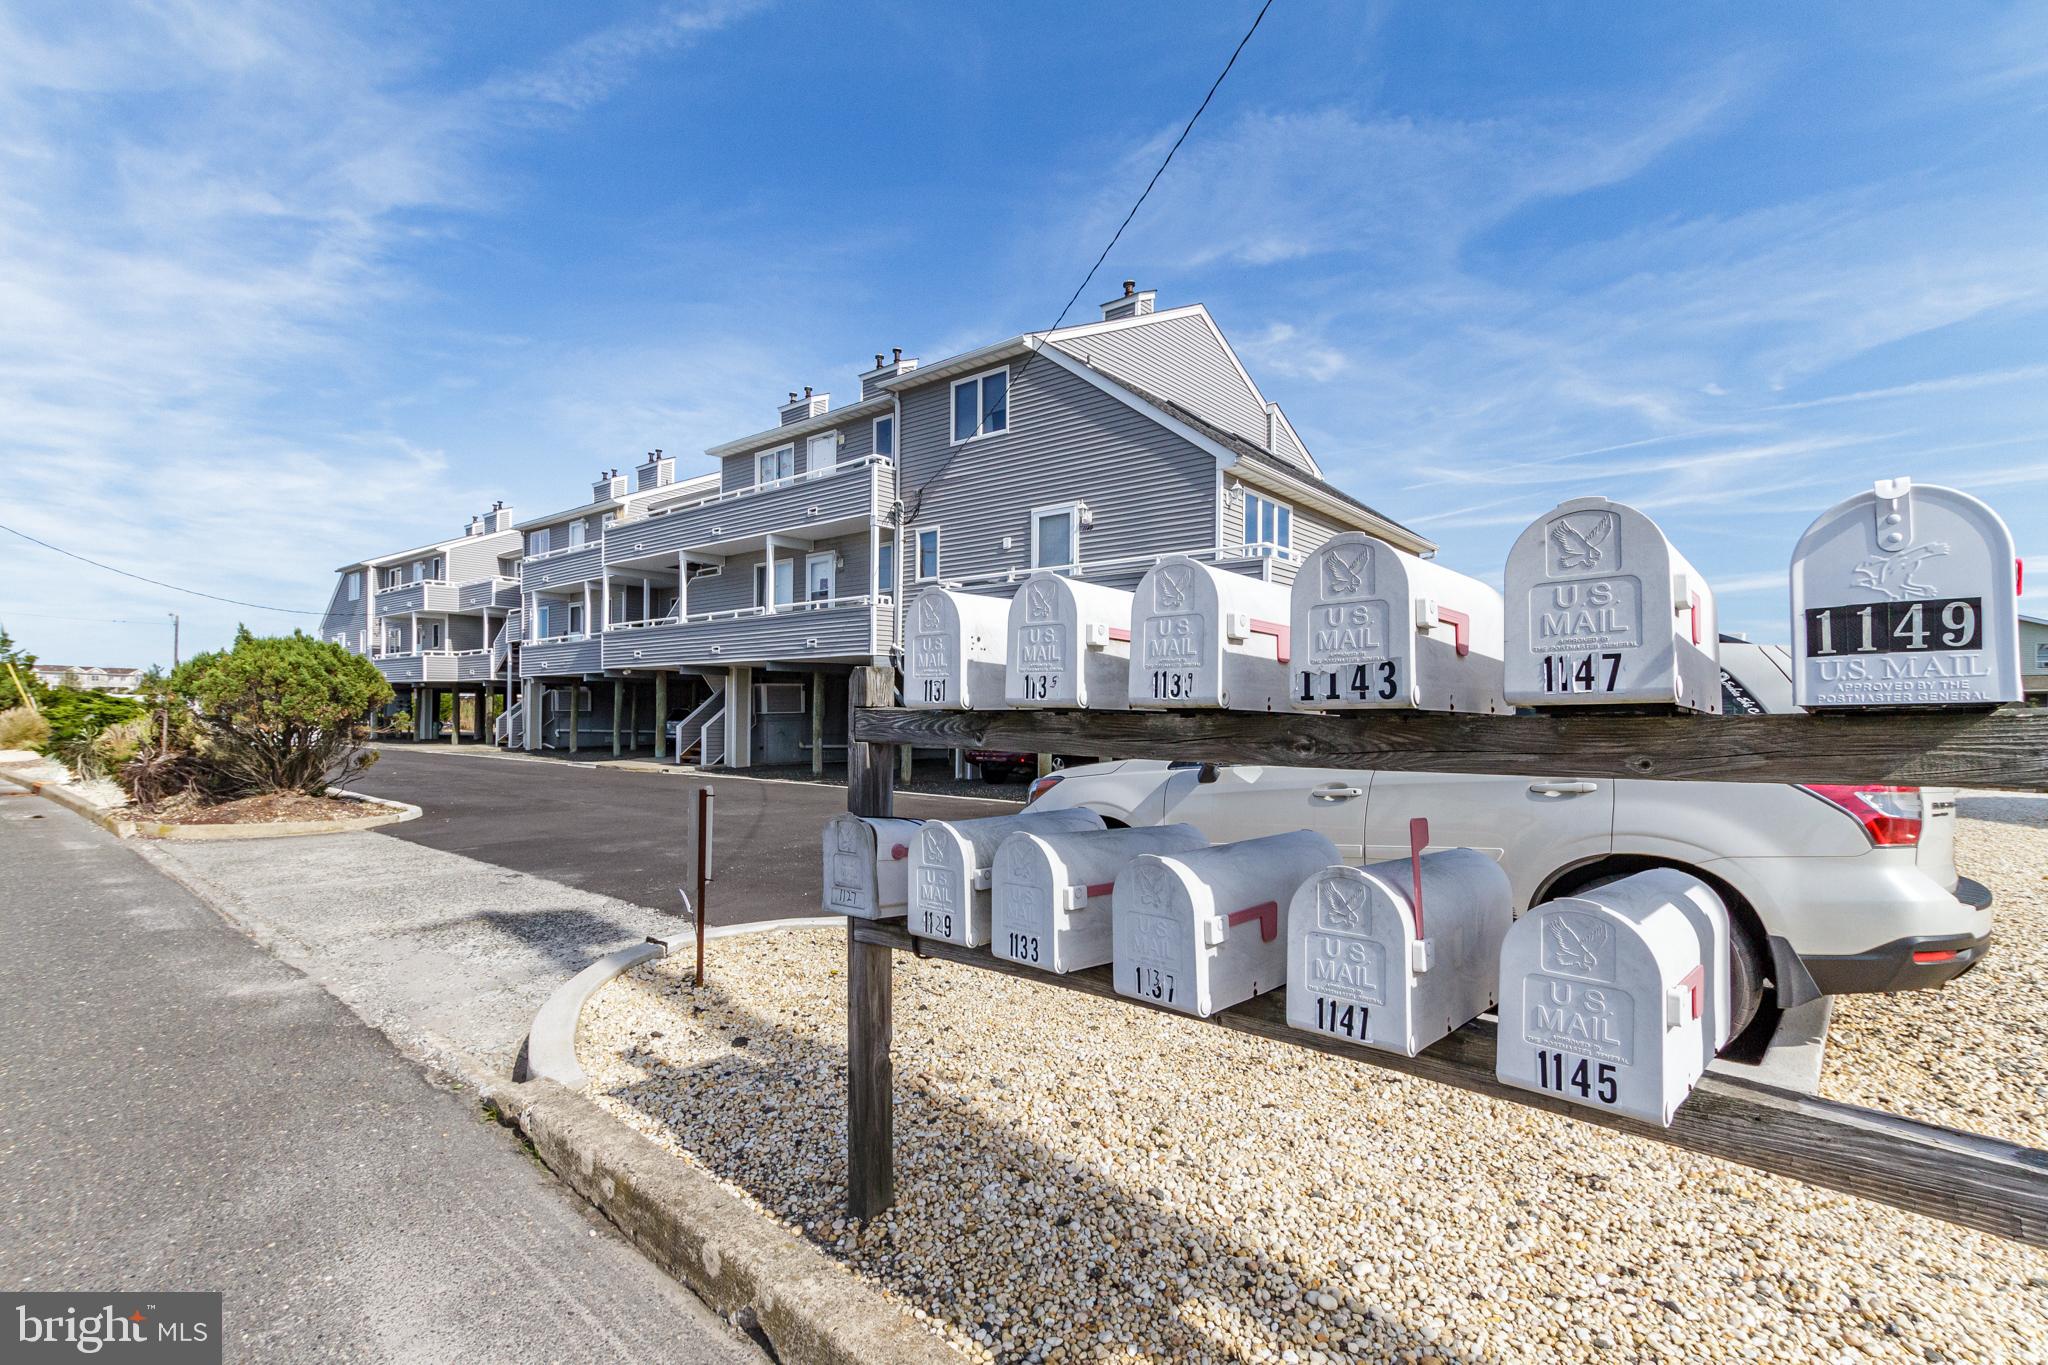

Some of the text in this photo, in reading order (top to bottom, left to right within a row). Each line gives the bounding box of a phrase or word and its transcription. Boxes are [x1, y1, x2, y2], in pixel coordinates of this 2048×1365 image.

[1542, 608, 1629, 636] MAIL
[1815, 601, 1976, 654] 1149
[1151, 637, 1197, 657] MAIL
[1318, 628, 1380, 650] MAIL
[918, 652, 948, 669] MAIL
[1023, 644, 1062, 662] MAIL
[1815, 653, 1992, 681] U.S. MAIL
[924, 679, 946, 702] 1131
[1024, 674, 1058, 699] 1135
[1300, 660, 1398, 701] 1143
[1837, 679, 1970, 692] APPROVED BY THE
[1818, 690, 1992, 704] POSTMASTER GENERAL
[920, 885, 953, 903] MAIL
[924, 911, 952, 938] 1129
[1010, 932, 1040, 962] 1133
[1314, 958, 1377, 990] MAIL
[1535, 1004, 1621, 1047] MAIL
[1538, 1050, 1617, 1104] 1145
